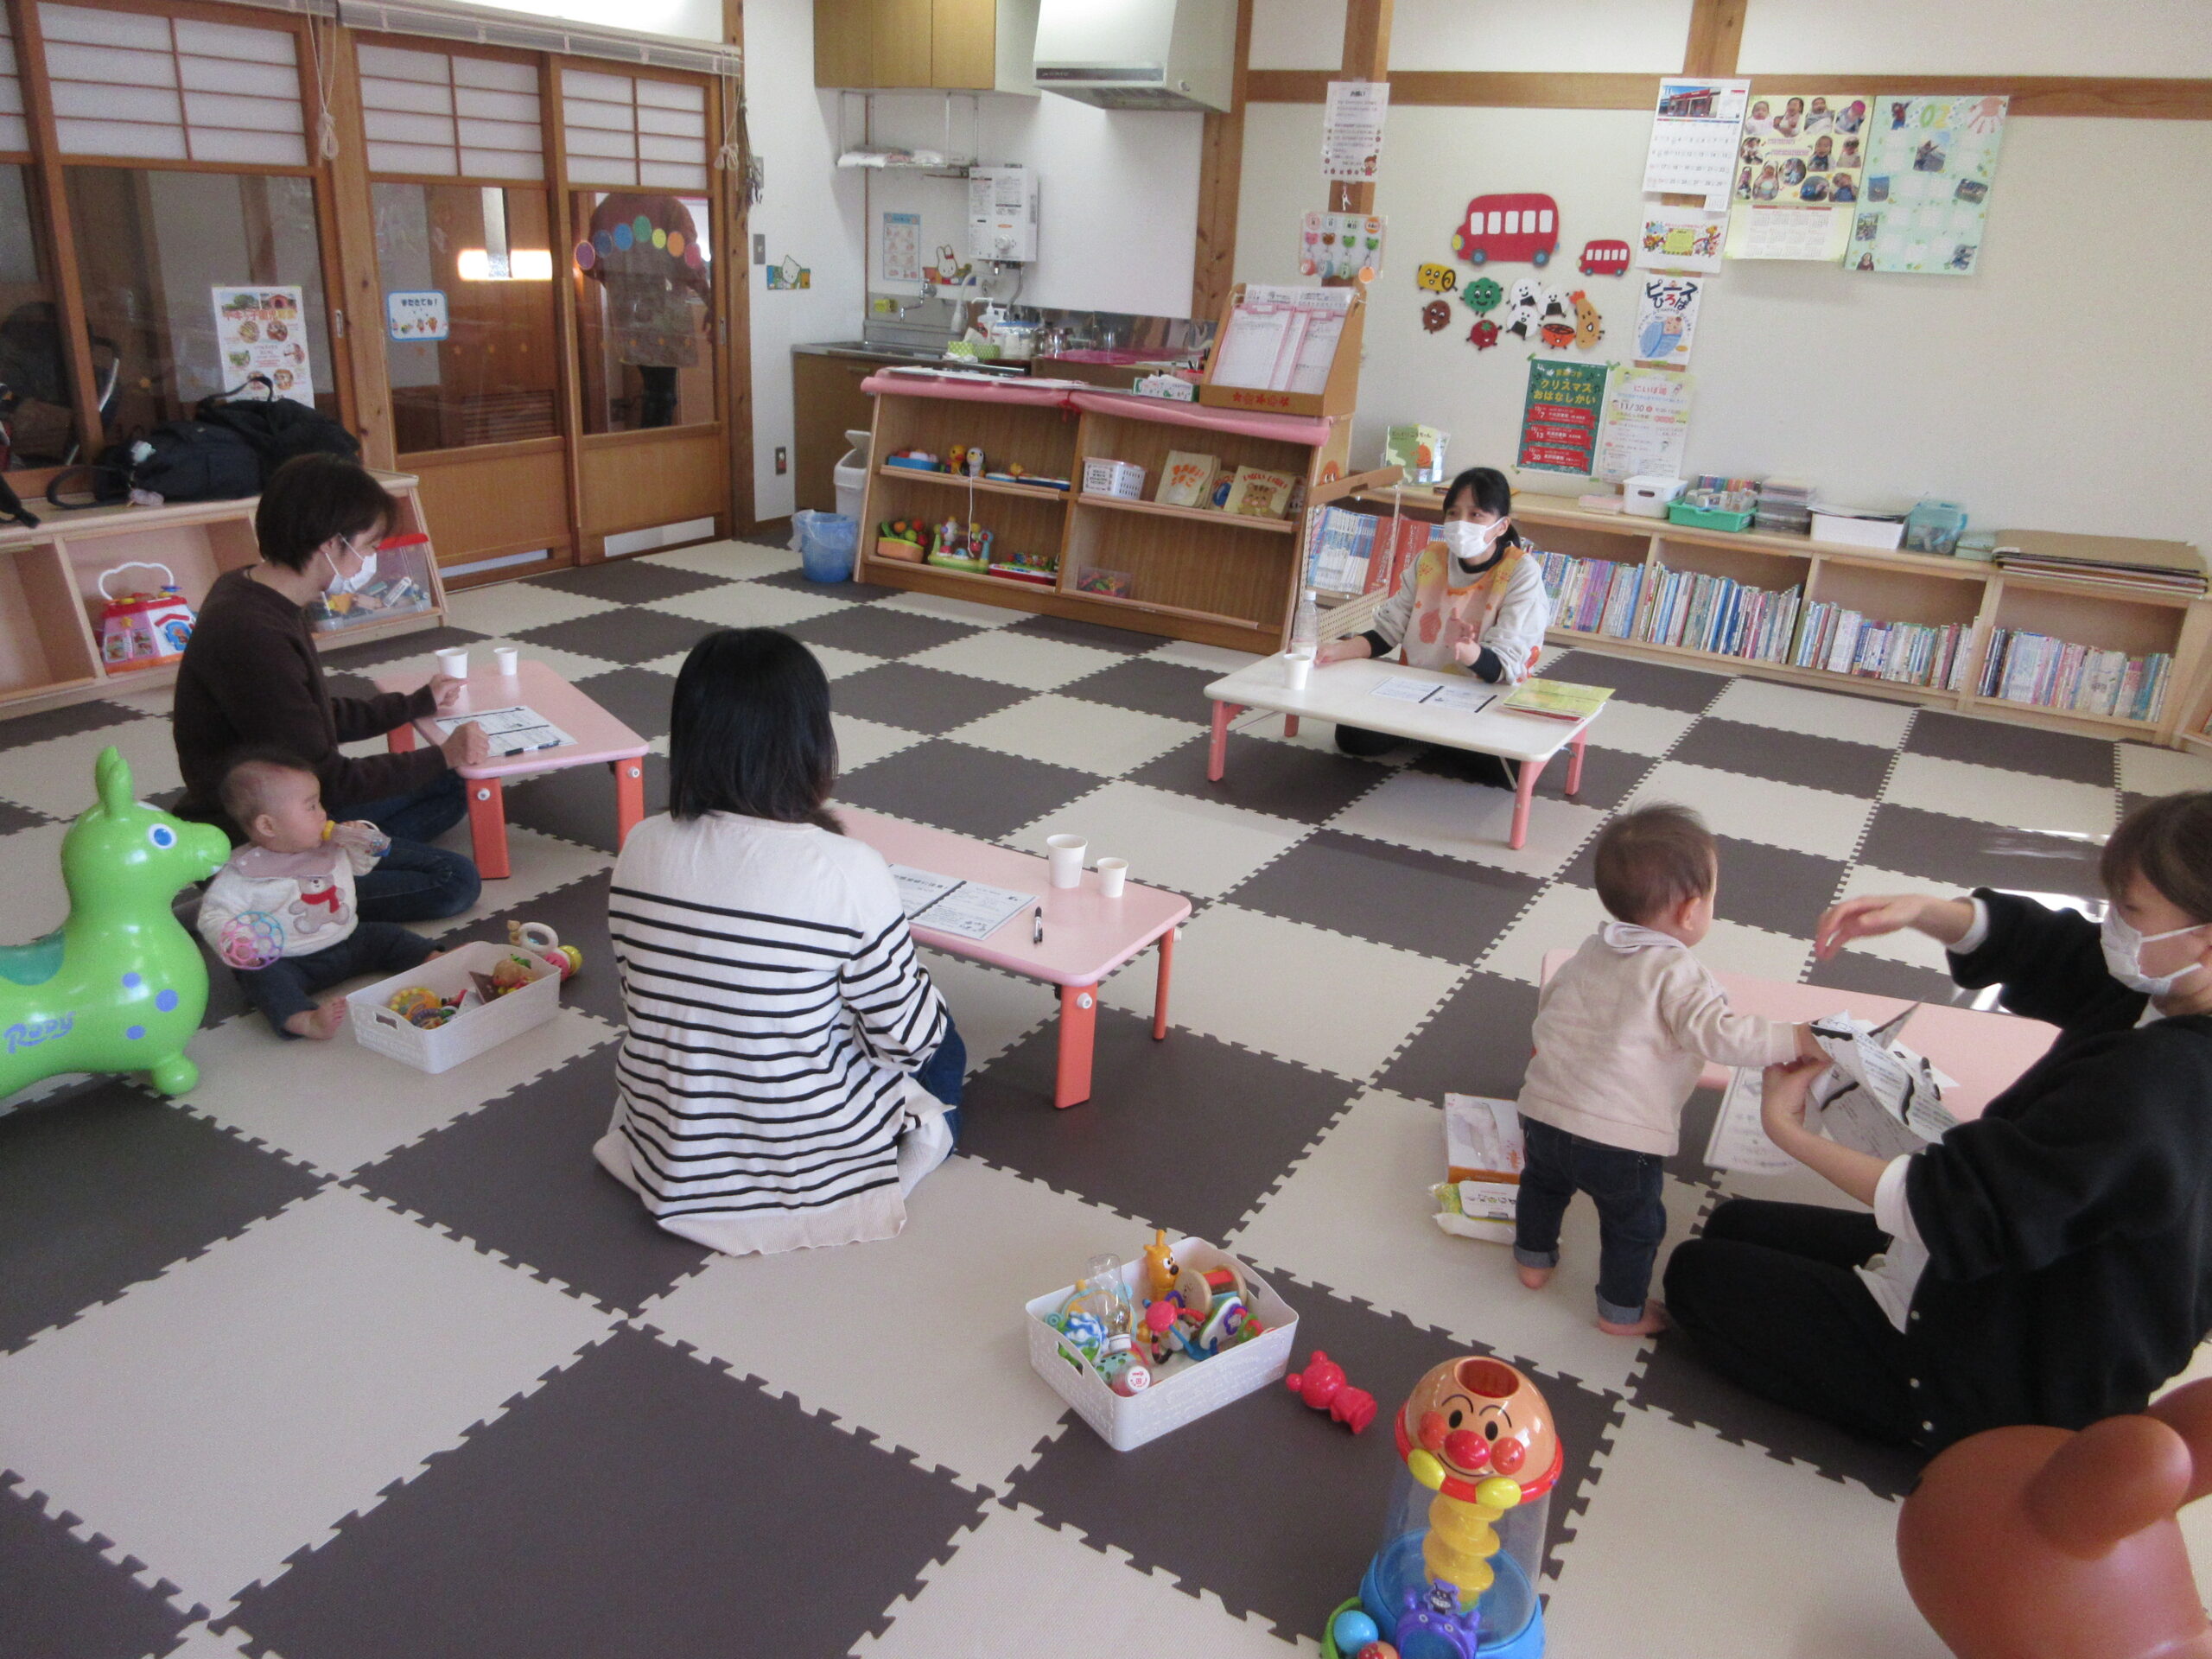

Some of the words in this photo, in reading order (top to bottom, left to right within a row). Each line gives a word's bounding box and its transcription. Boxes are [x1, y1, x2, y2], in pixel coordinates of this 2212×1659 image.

[1645, 278, 1698, 302] ピース
[1541, 379, 1592, 393] クリスマス
[1534, 390, 1597, 404] おはなしかい
[1620, 402, 1645, 412] 11/30
[3, 1011, 76, 1053] Rody
